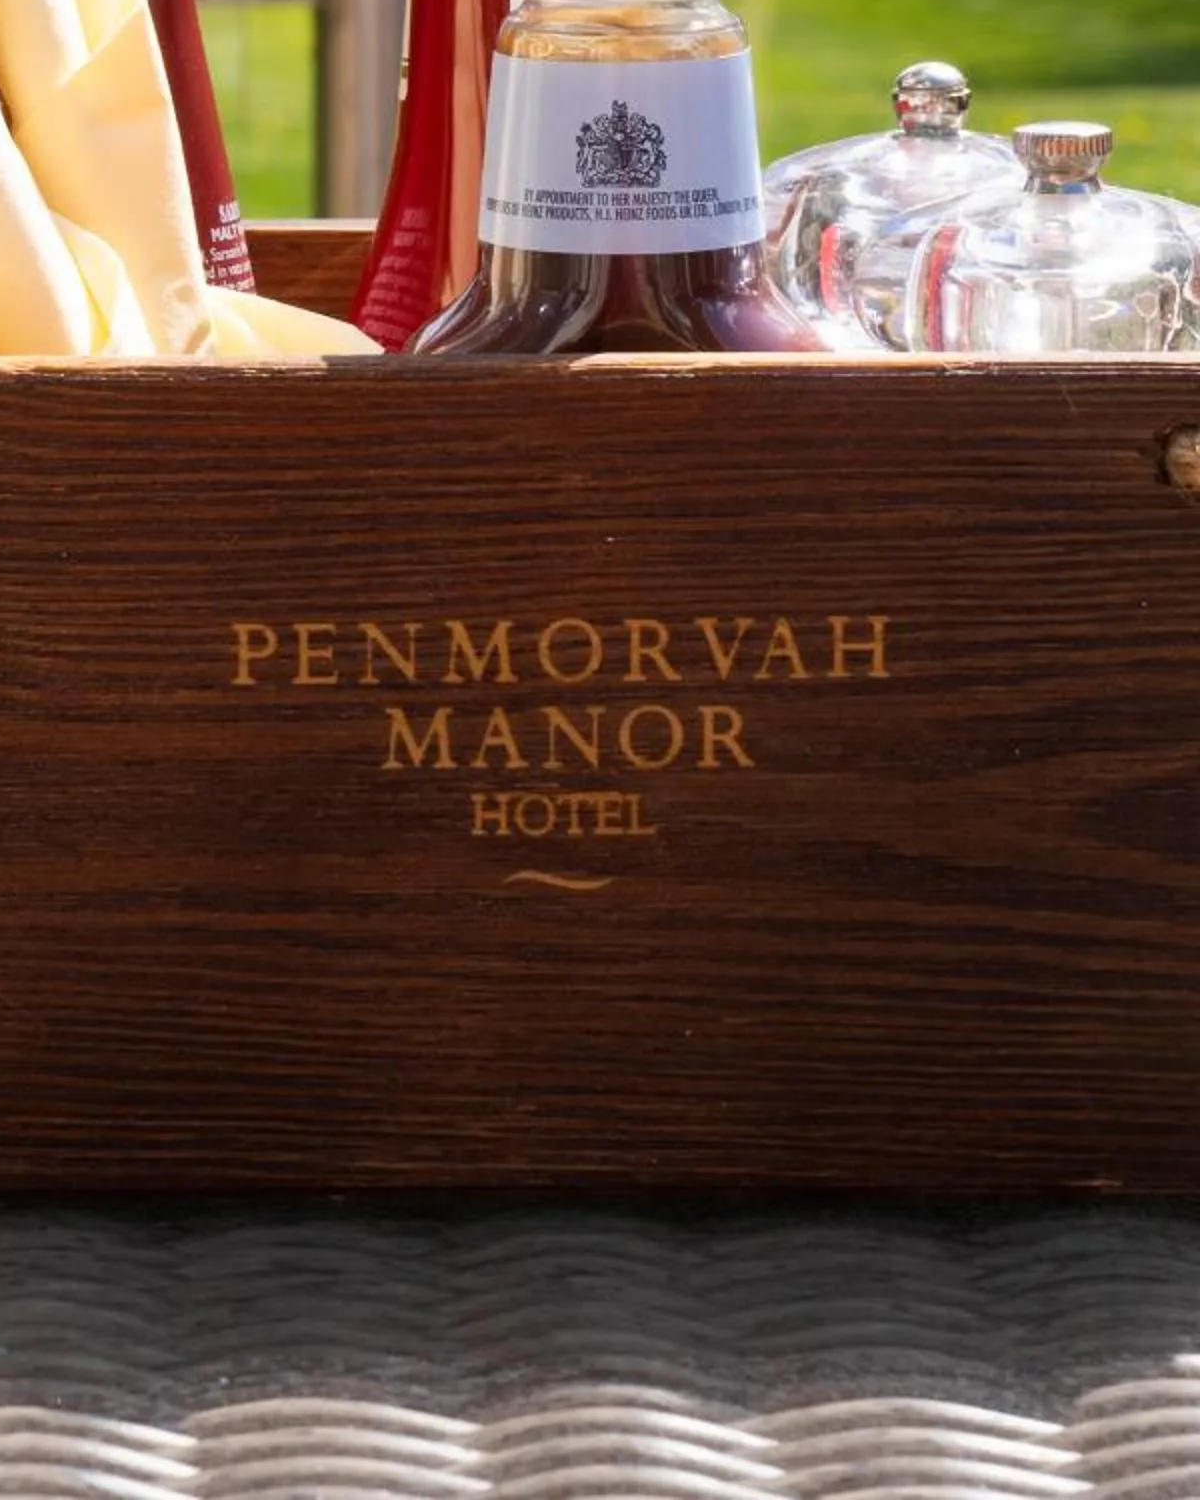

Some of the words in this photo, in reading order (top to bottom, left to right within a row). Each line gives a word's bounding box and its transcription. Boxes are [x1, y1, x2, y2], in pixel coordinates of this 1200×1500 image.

[535, 189, 594, 204] APPOINTMENT
[596, 192, 609, 205] TO
[611, 192, 631, 205] HER
[633, 190, 672, 204] MAJESTY
[674, 189, 691, 203] THE
[615, 206, 644, 220] HEINZ
[646, 204, 677, 220] FOODS
[231, 615, 891, 686] PENMORVAH
[382, 704, 755, 771] MANOR
[471, 791, 657, 837] HOTEL
